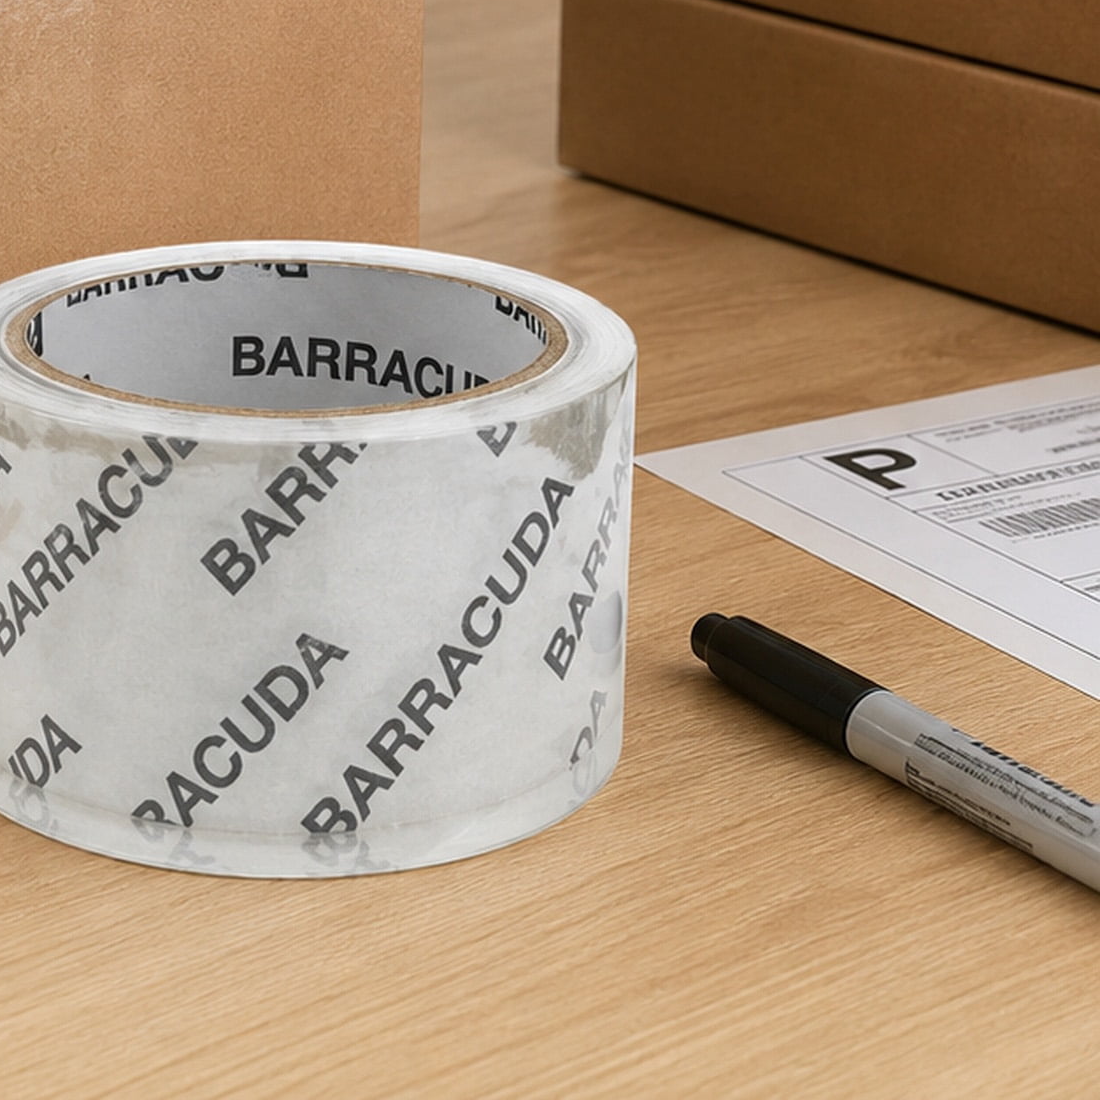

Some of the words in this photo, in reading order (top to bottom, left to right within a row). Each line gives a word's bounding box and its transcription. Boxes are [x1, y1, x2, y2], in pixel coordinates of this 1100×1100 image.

[200, 442, 368, 597] BARR
[822, 448, 918, 491] P
[300, 477, 576, 834] BARRACUDA
